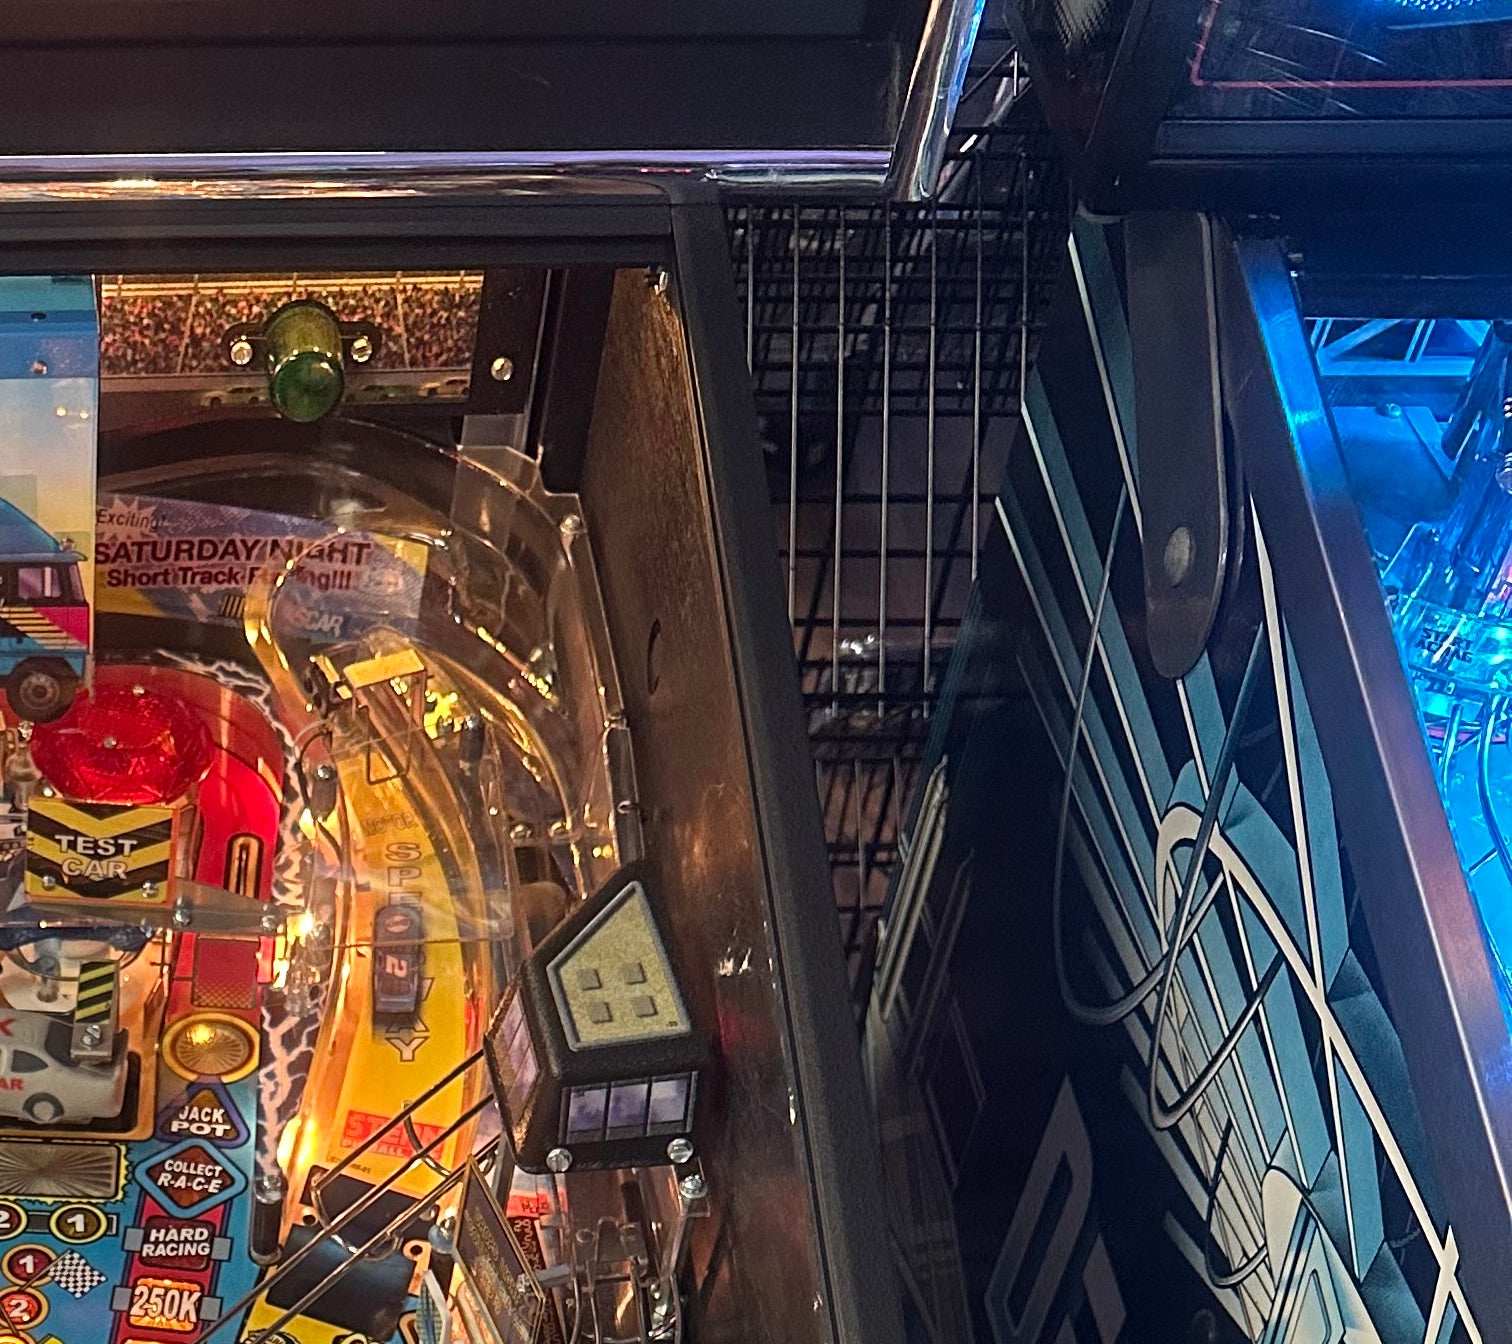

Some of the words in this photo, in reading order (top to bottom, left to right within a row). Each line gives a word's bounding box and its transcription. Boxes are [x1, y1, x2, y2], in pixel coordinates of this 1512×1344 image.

[94, 537, 262, 566] SATURDAY
[107, 566, 170, 588] Short
[175, 566, 240, 588] Track
[55, 834, 138, 857] TEST
[61, 858, 129, 881] CAR
[177, 1105, 225, 1123] JACK
[169, 1120, 232, 1138] POT
[163, 1158, 224, 1179] COLLECT
[157, 1172, 223, 1195] R-A-C-E
[149, 1226, 211, 1246] HARD
[140, 1241, 212, 1259] RACING
[133, 1285, 201, 1323] 250K
